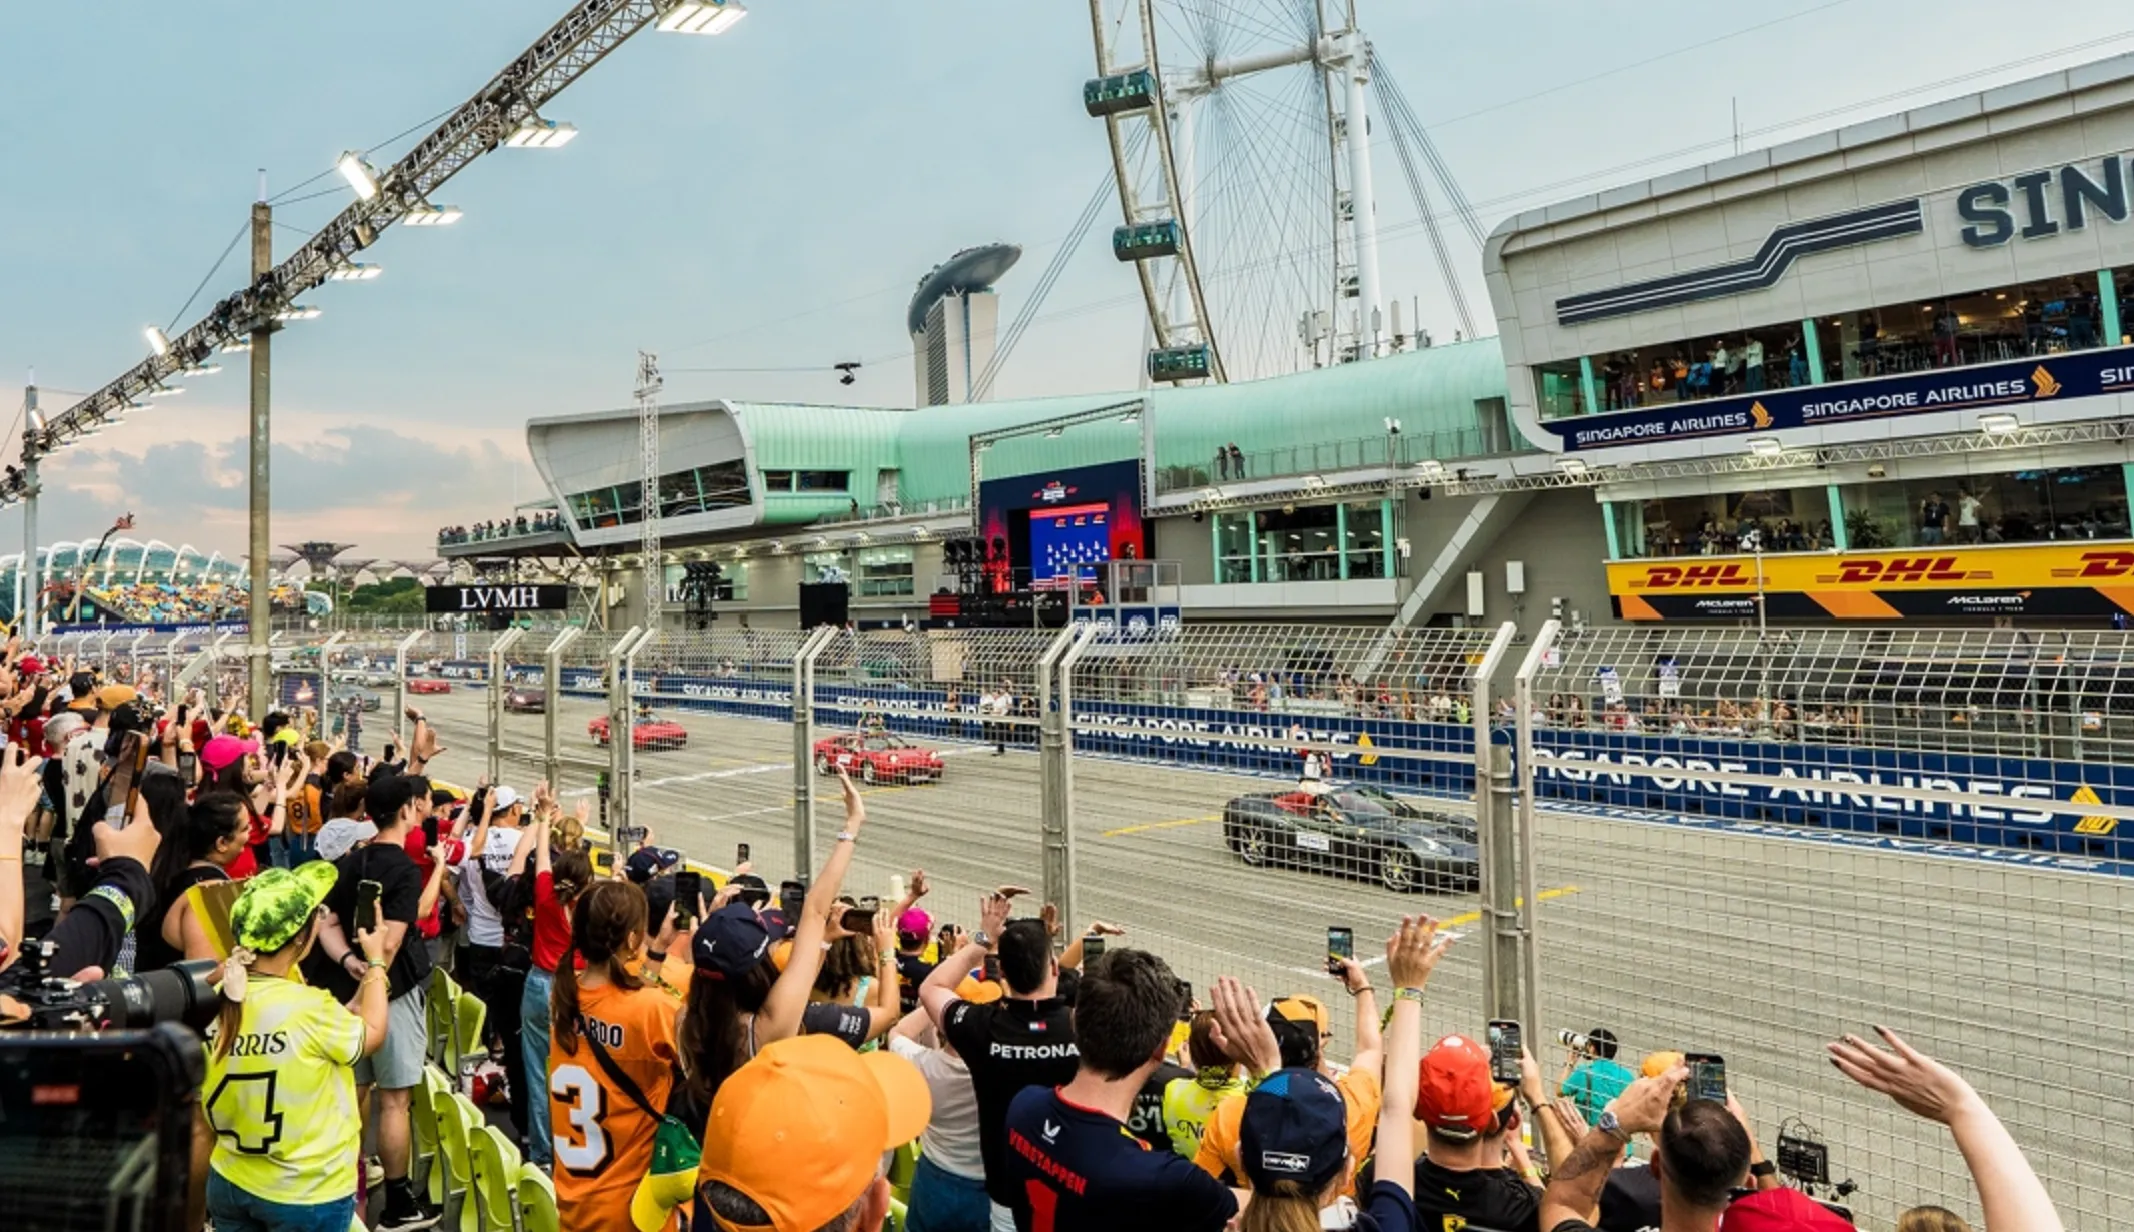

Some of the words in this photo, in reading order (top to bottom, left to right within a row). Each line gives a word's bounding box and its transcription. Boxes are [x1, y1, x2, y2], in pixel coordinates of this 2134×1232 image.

[1957, 155, 2134, 248] SIN
[1801, 392, 1918, 418] SINGAPORE
[1925, 379, 2026, 404] AIRLINES
[1576, 422, 1665, 444] SINGAPORE
[1670, 412, 1747, 433] AIRLINES
[1646, 564, 1750, 588] DHL
[1838, 557, 1967, 583] DHL
[2080, 552, 2134, 578] D
[460, 586, 540, 609] LVMH
[1075, 714, 1210, 747] SINGAPORE
[1510, 745, 1750, 797] NGAPORE
[1769, 767, 2054, 825] AIRLINES
[989, 1042, 1081, 1060] PETRONA
[206, 1071, 284, 1155] 4
[551, 1063, 611, 1176] 3
[1009, 1127, 1087, 1195] VERSTAPPEN
